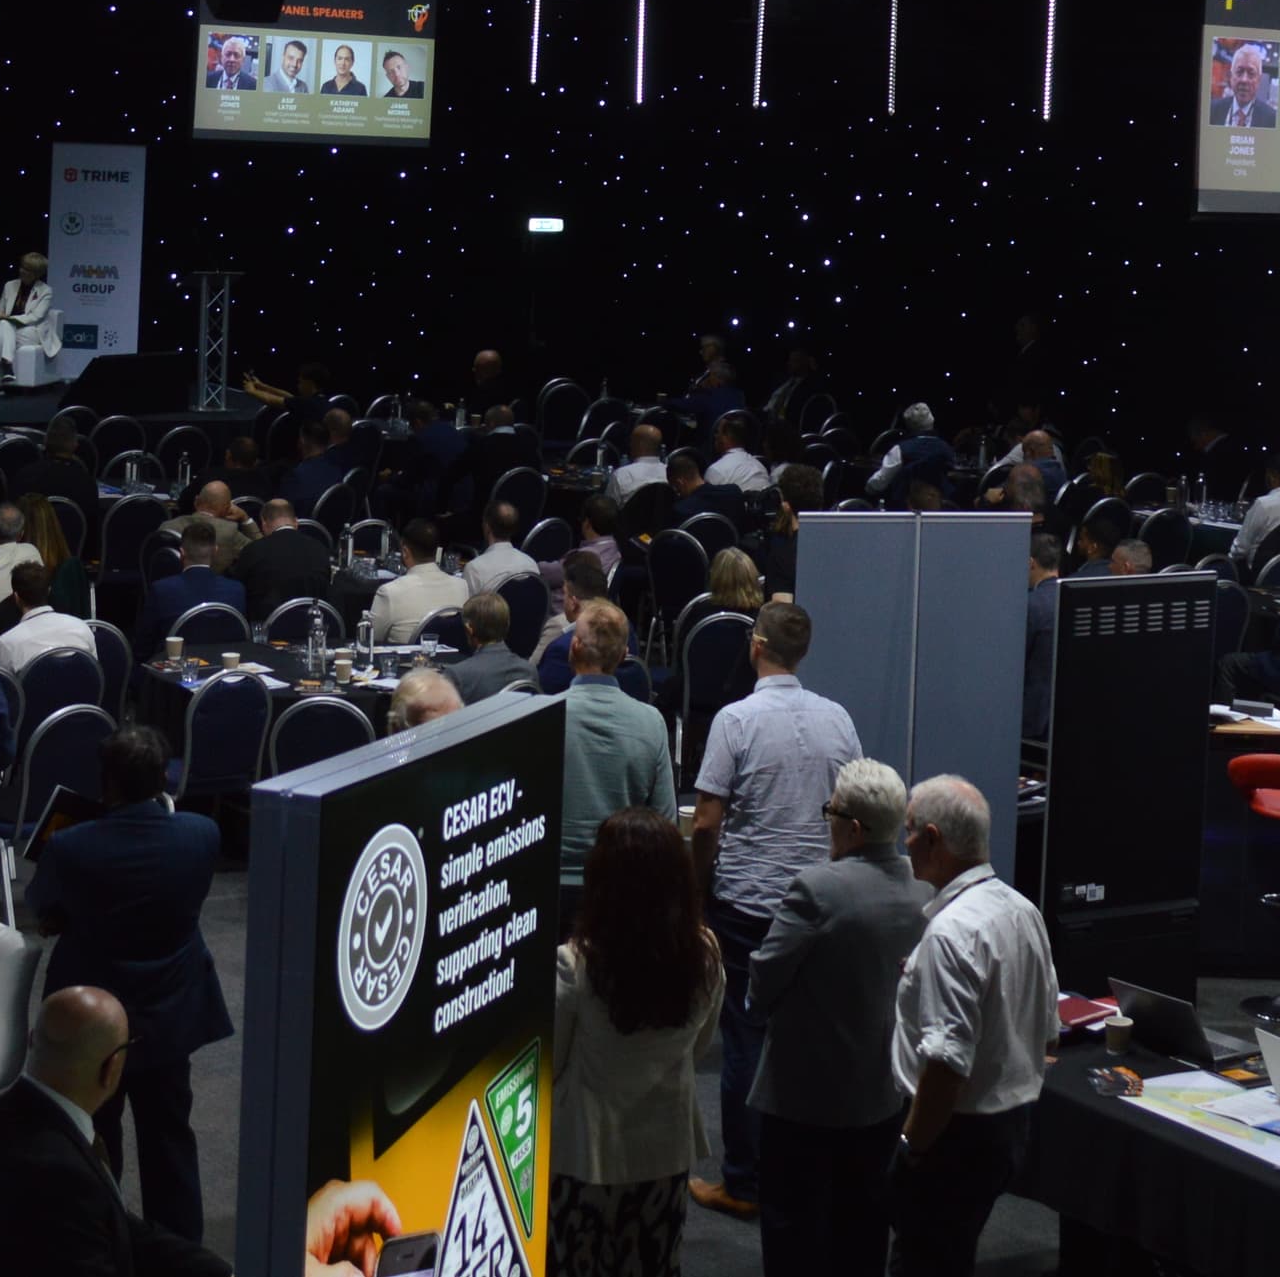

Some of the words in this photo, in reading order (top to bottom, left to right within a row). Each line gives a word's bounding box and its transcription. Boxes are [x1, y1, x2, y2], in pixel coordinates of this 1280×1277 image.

[312, 7, 364, 19] SPEAKERS
[81, 169, 130, 183] TRIME
[73, 283, 115, 294] GROUP
[443, 791, 488, 841] CESAR
[489, 778, 516, 819] ECV
[355, 852, 414, 916] CESAR
[440, 843, 484, 890] simple
[486, 815, 546, 866] emissions
[439, 879, 511, 937] verification,
[353, 936, 411, 1001] CESAR
[436, 928, 502, 985] supporting
[505, 908, 537, 948] clean
[435, 958, 515, 1034] construction!
[515, 1083, 532, 1138] 5
